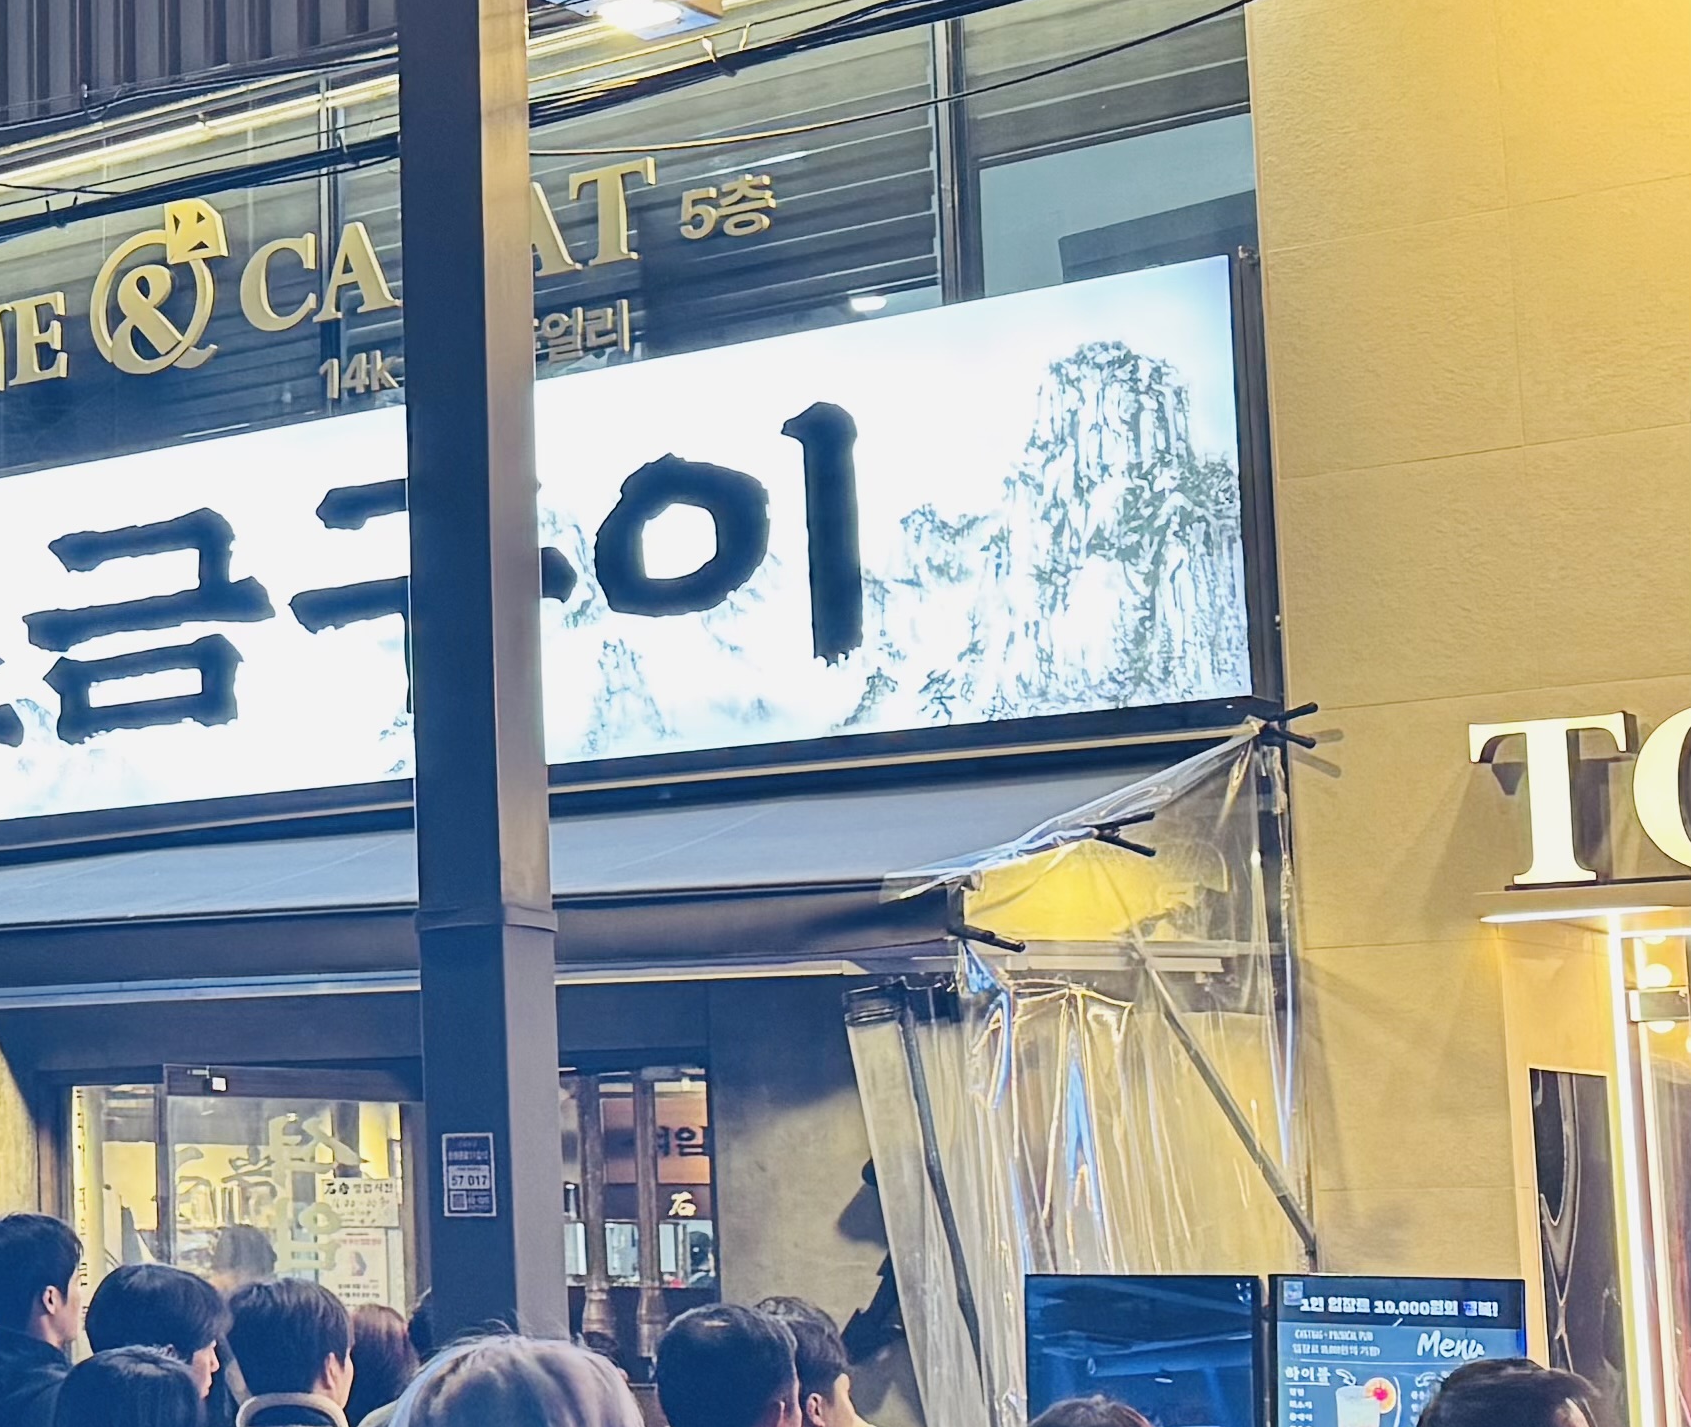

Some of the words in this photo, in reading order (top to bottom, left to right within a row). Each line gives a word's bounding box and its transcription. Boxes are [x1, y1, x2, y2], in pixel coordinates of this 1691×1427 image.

[239, 156, 657, 334] CAAT
[679, 174, 777, 240] 5층
[534, 298, 630, 364] 얼리
[1416, 1329, 1486, 1361] Menu
